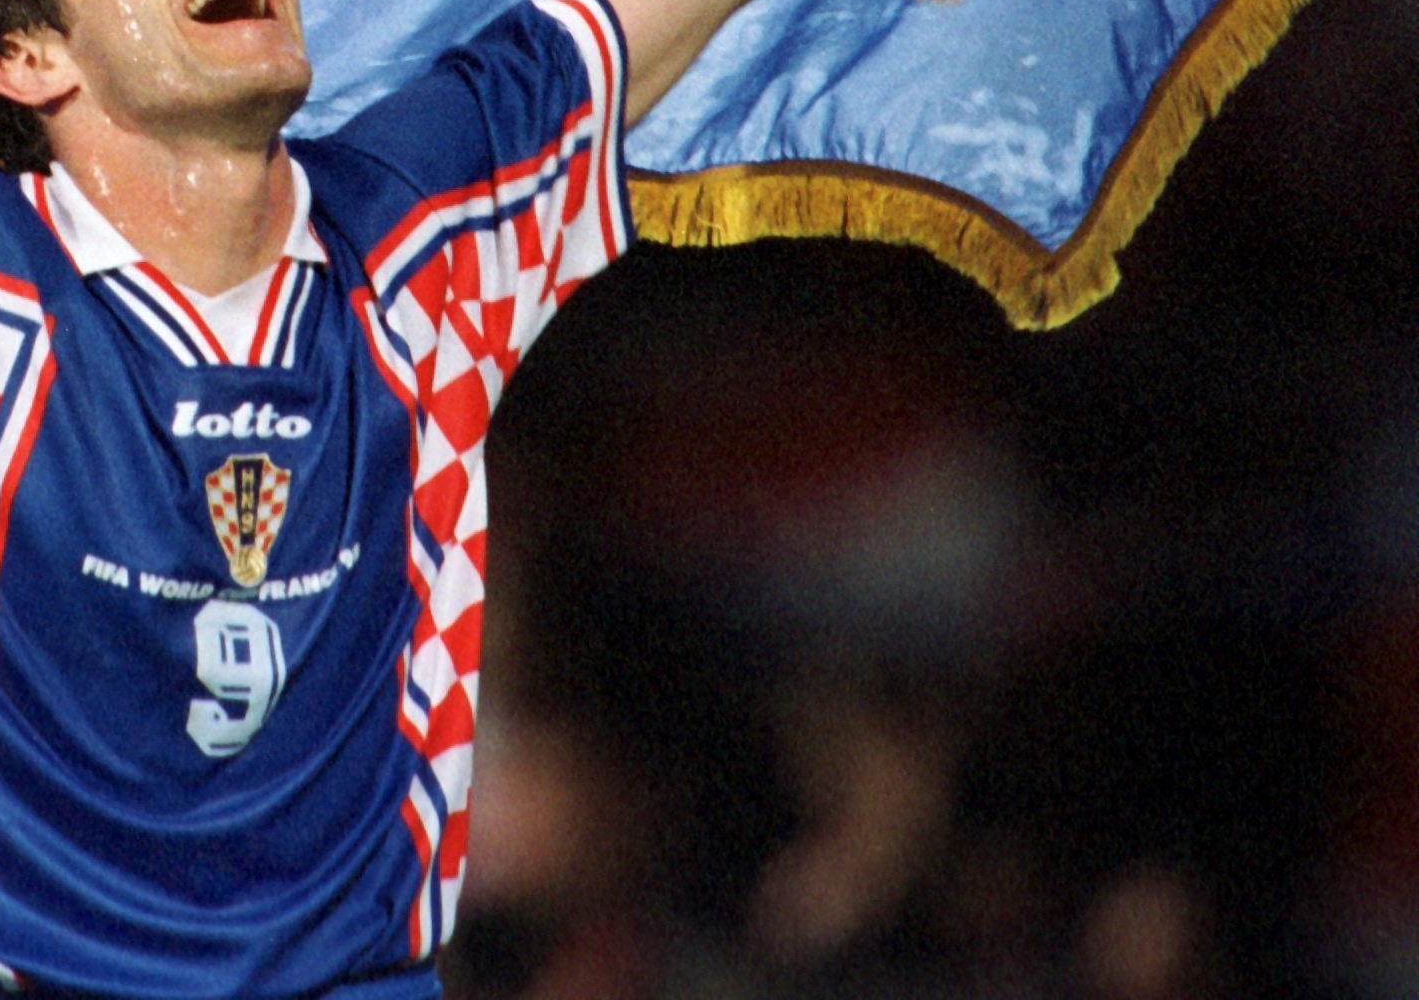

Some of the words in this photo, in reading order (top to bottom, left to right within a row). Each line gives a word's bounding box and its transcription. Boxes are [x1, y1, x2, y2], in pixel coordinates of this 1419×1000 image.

[171, 401, 312, 439] lotto
[82, 554, 129, 588] FIFA
[140, 571, 214, 599] WORLD
[259, 565, 338, 602] FRANC
[186, 599, 286, 757] 9
